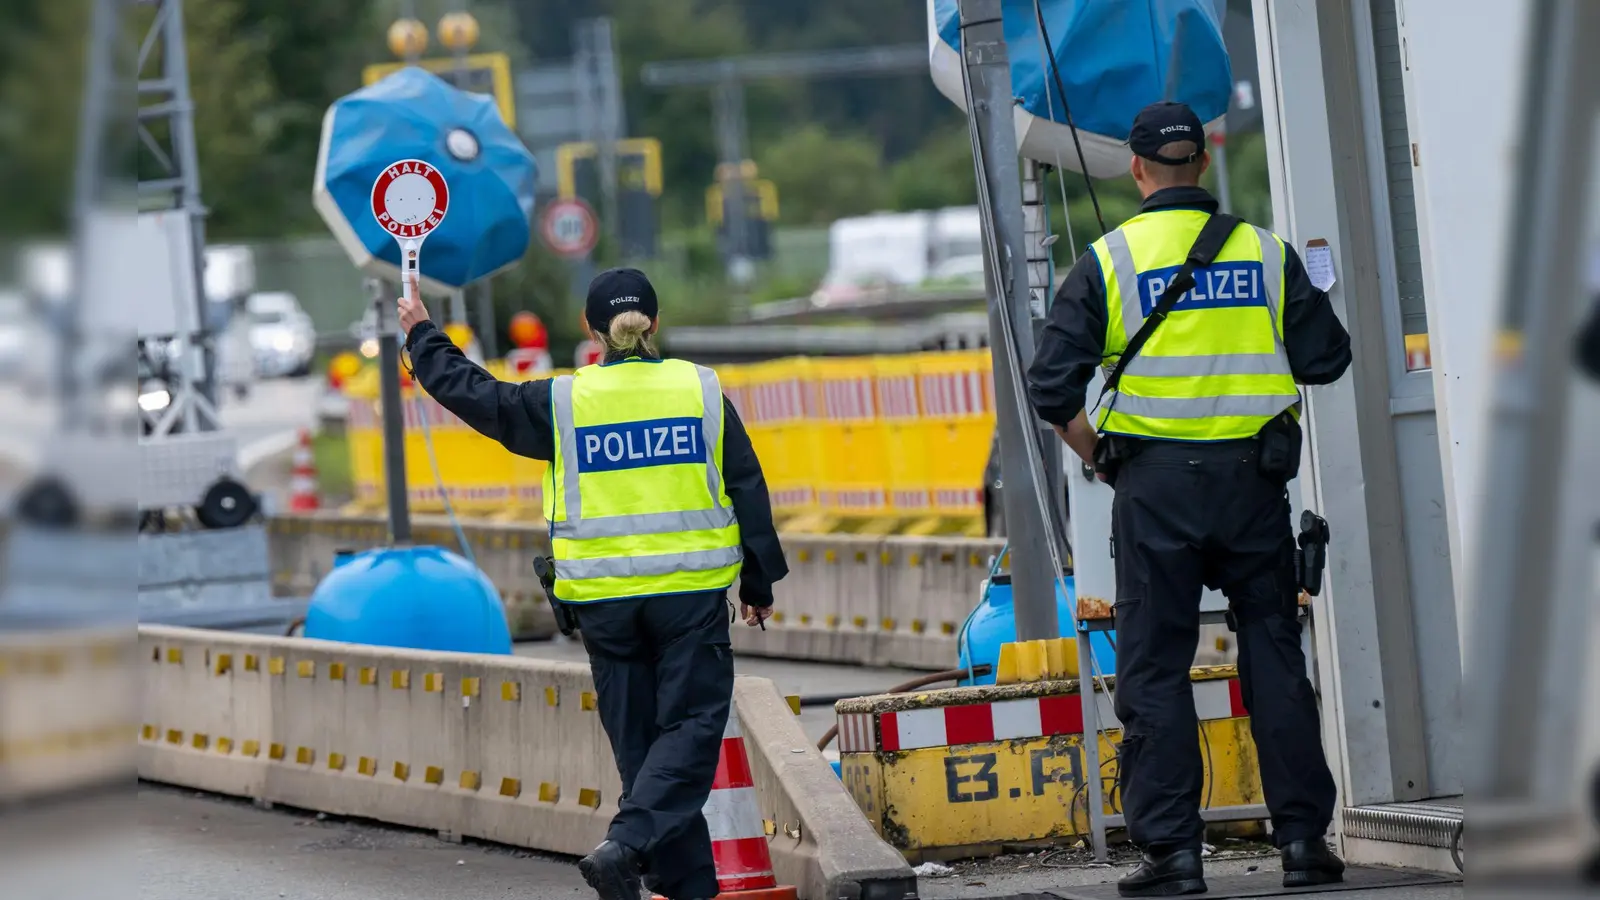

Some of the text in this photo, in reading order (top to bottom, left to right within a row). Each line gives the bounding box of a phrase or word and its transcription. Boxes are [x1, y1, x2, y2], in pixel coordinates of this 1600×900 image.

[1160, 125, 1191, 135] POLIZEI
[387, 163, 433, 179] HALT
[378, 208, 444, 236] POLIZEI
[610, 296, 640, 306] POLIZEI
[584, 425, 697, 464] POLIZEI
